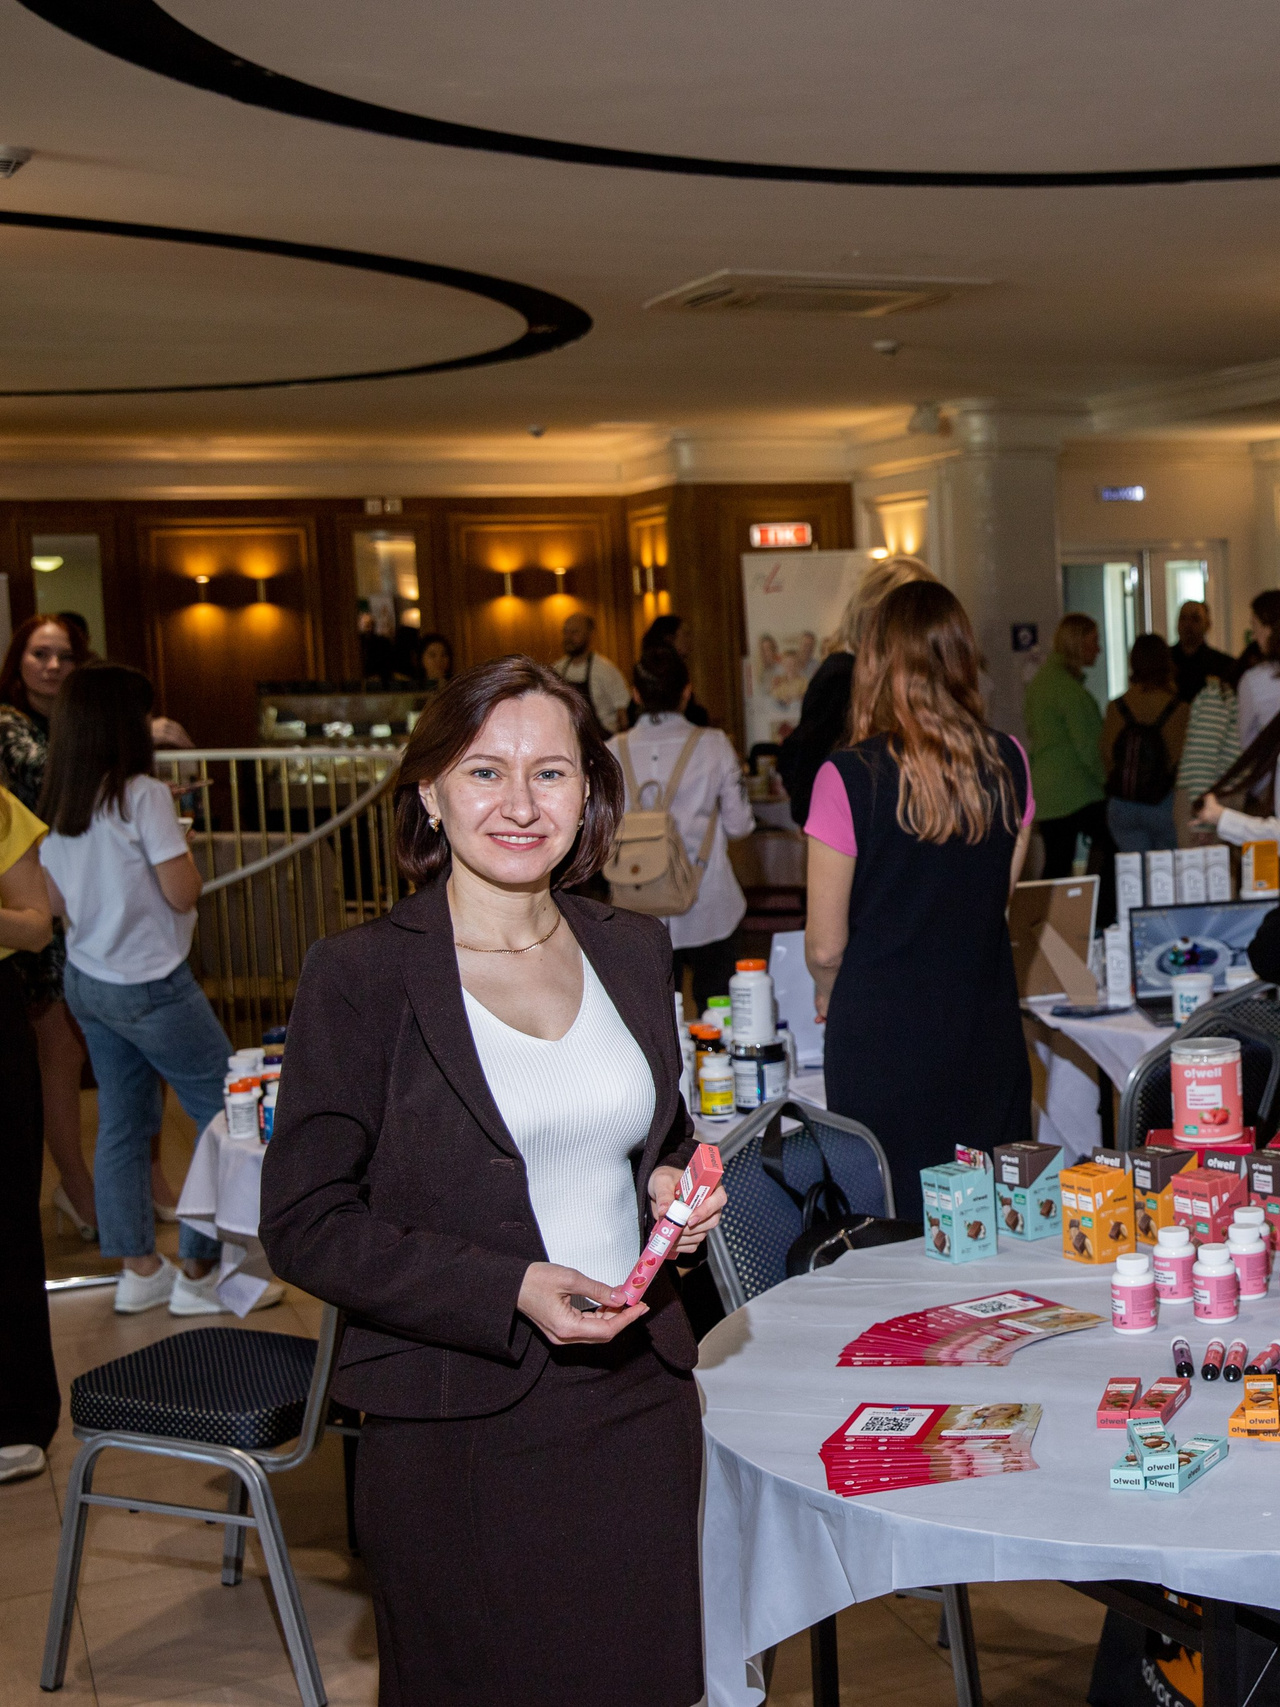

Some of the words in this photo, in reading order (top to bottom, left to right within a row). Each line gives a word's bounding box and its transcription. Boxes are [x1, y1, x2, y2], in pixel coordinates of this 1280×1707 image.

[1184, 1067, 1222, 1078] o!well
[1095, 1155, 1120, 1167] o!well
[1207, 1157, 1236, 1171] o!well
[661, 1226, 674, 1238] o!
[1147, 1463, 1175, 1472] o!well
[1113, 1478, 1141, 1486] o!well
[1149, 1479, 1175, 1489] o!well
